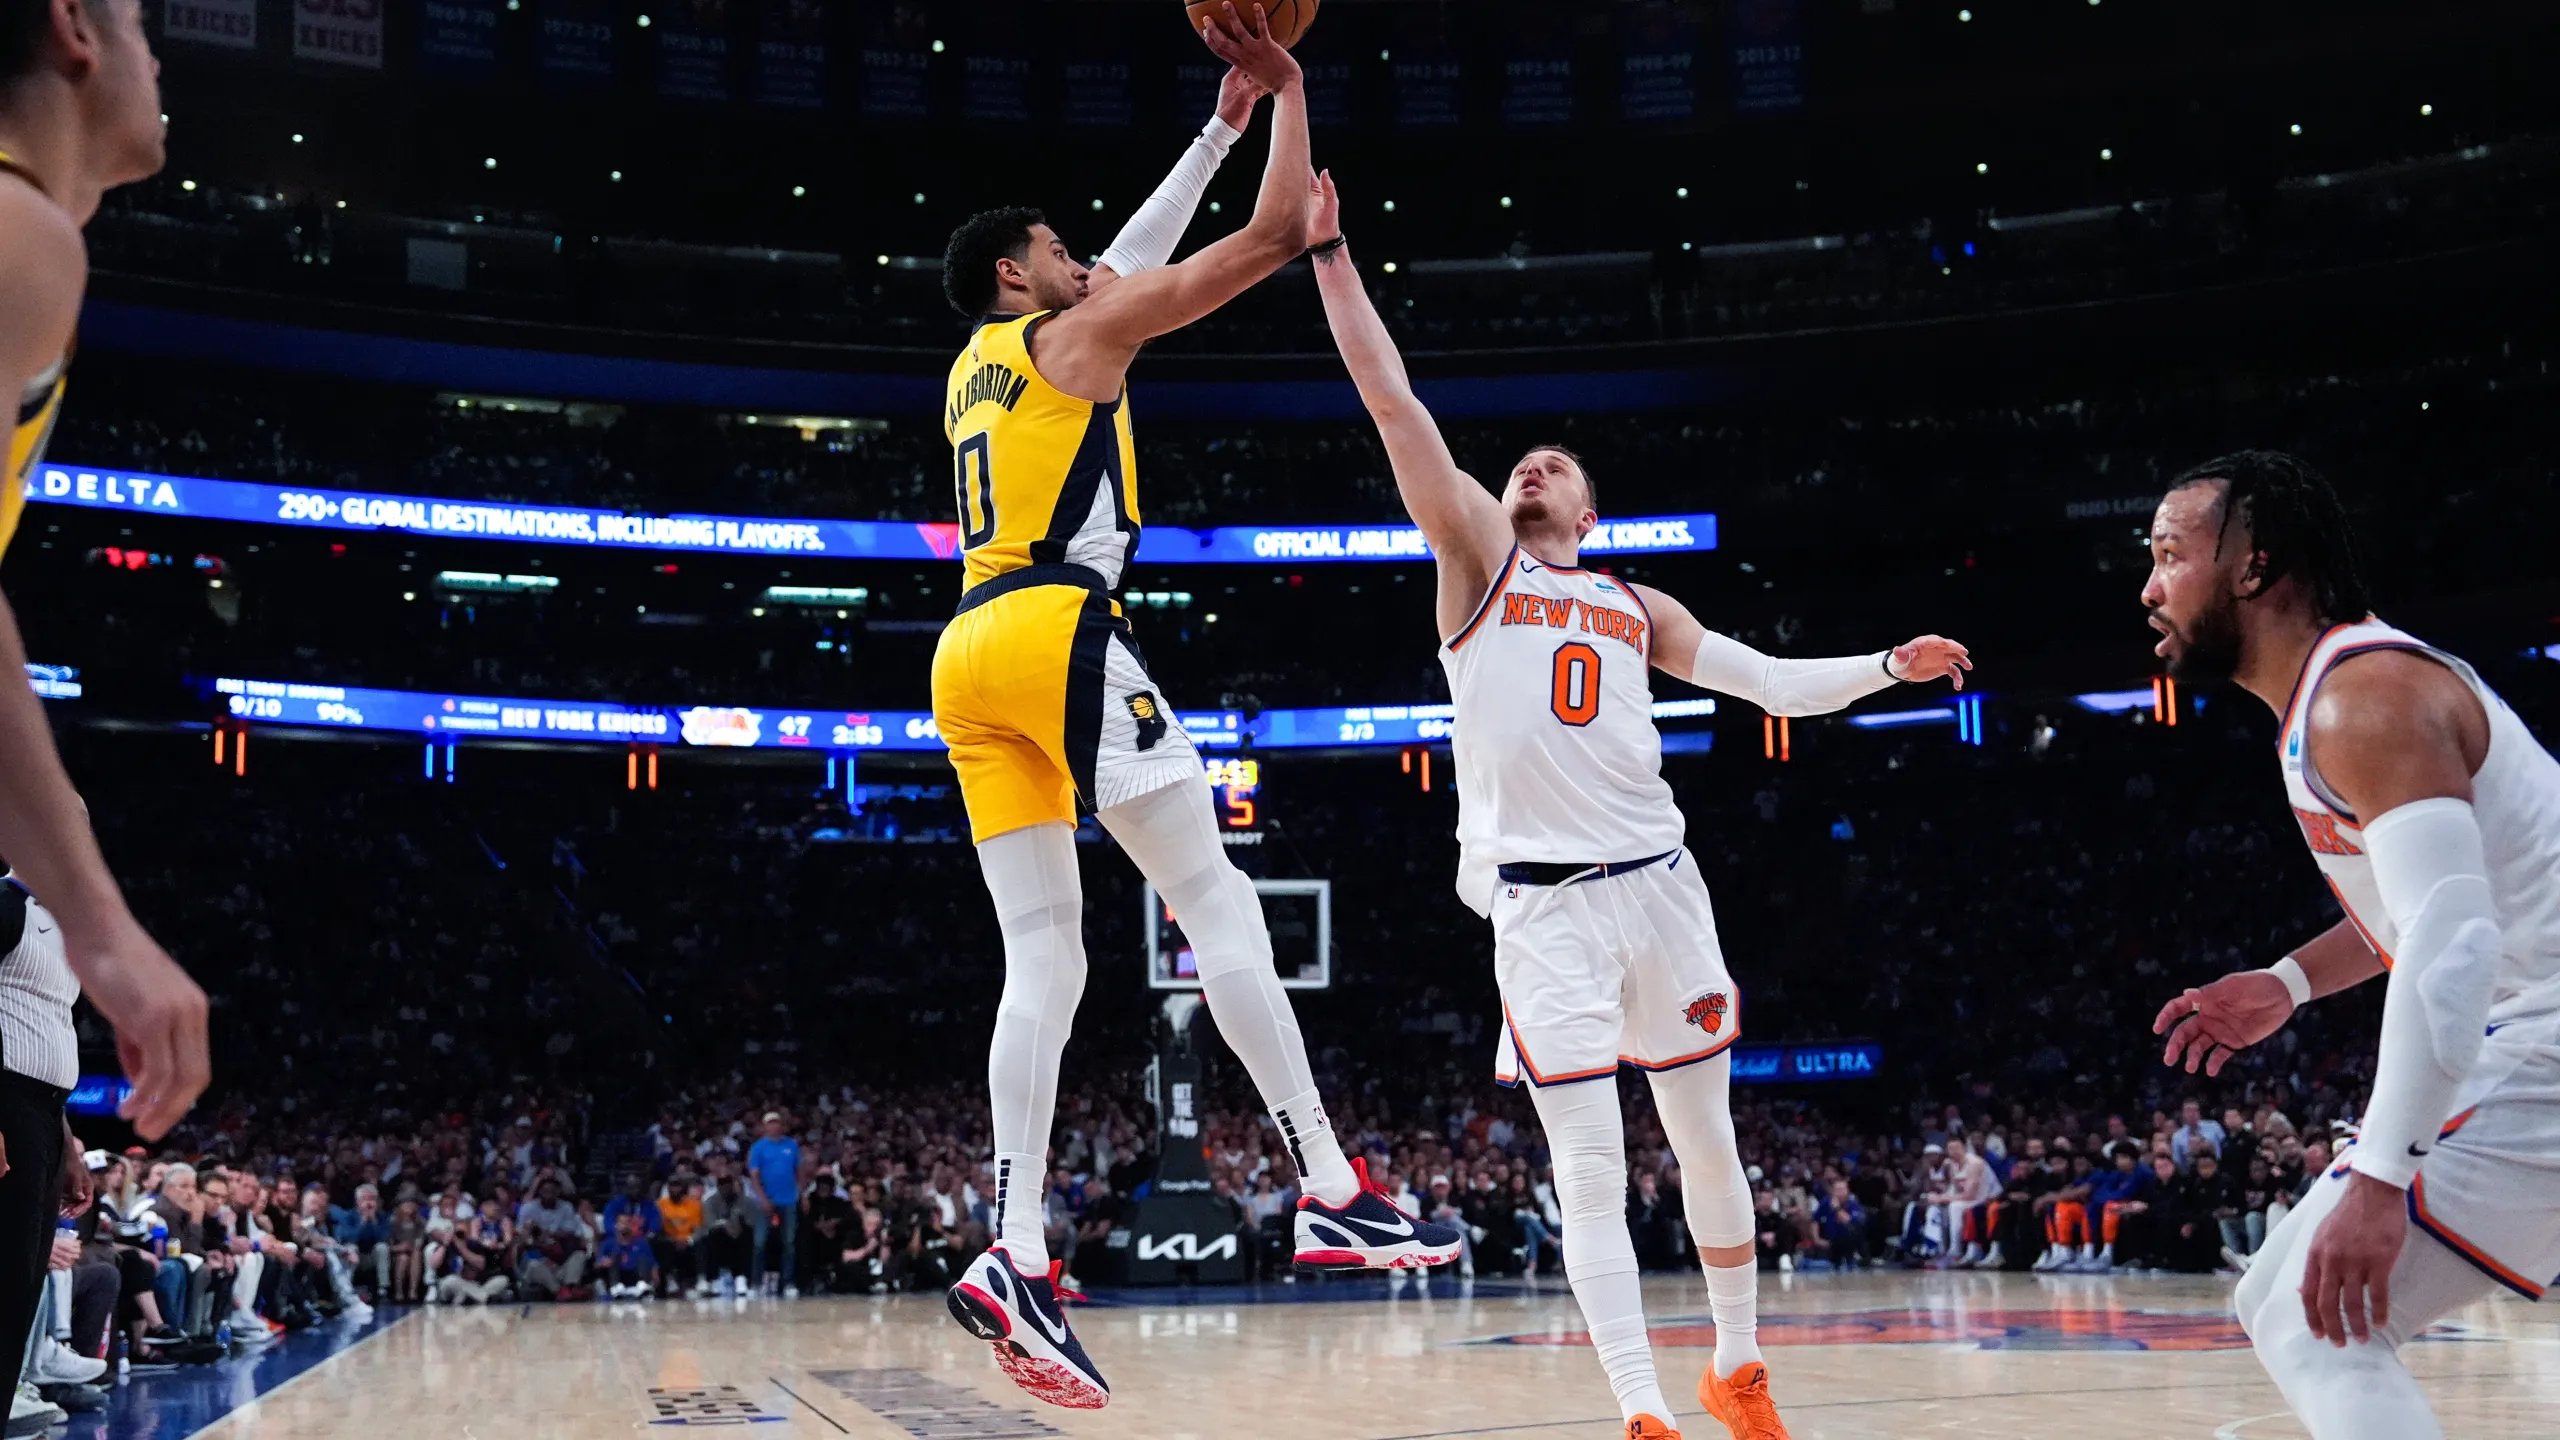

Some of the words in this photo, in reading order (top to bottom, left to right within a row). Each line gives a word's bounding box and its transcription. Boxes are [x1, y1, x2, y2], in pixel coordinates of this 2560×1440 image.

[300, 24, 379, 57] KNICKS
[949, 363, 1029, 437] ALIBURTON
[44, 469, 178, 508] DELTA
[957, 431, 998, 554] 0
[278, 492, 339, 520] 290+
[341, 497, 430, 529] GLOBAL
[431, 504, 597, 544] DESTINATIONS,
[598, 515, 715, 546] INCLUDING
[716, 520, 826, 551] PLAYOFFS.
[1254, 530, 1345, 557] OFFICIAL
[1346, 529, 1428, 556] AIRLINE
[1612, 520, 1695, 549] KNICKS.
[1501, 592, 1574, 629] NEW
[1575, 599, 1646, 656] YORK
[1550, 641, 1602, 728] 0
[229, 695, 282, 718] 9/10
[316, 701, 364, 726] 90%
[501, 706, 541, 729] NEW
[544, 708, 595, 731] YORK
[597, 711, 668, 735] KNICKS
[777, 715, 812, 737] 47
[832, 725, 884, 745] 2:53
[1227, 784, 1255, 826] 5
[1686, 992, 1728, 1022] KNICKS
[1796, 1051, 1872, 1074] ULTRA
